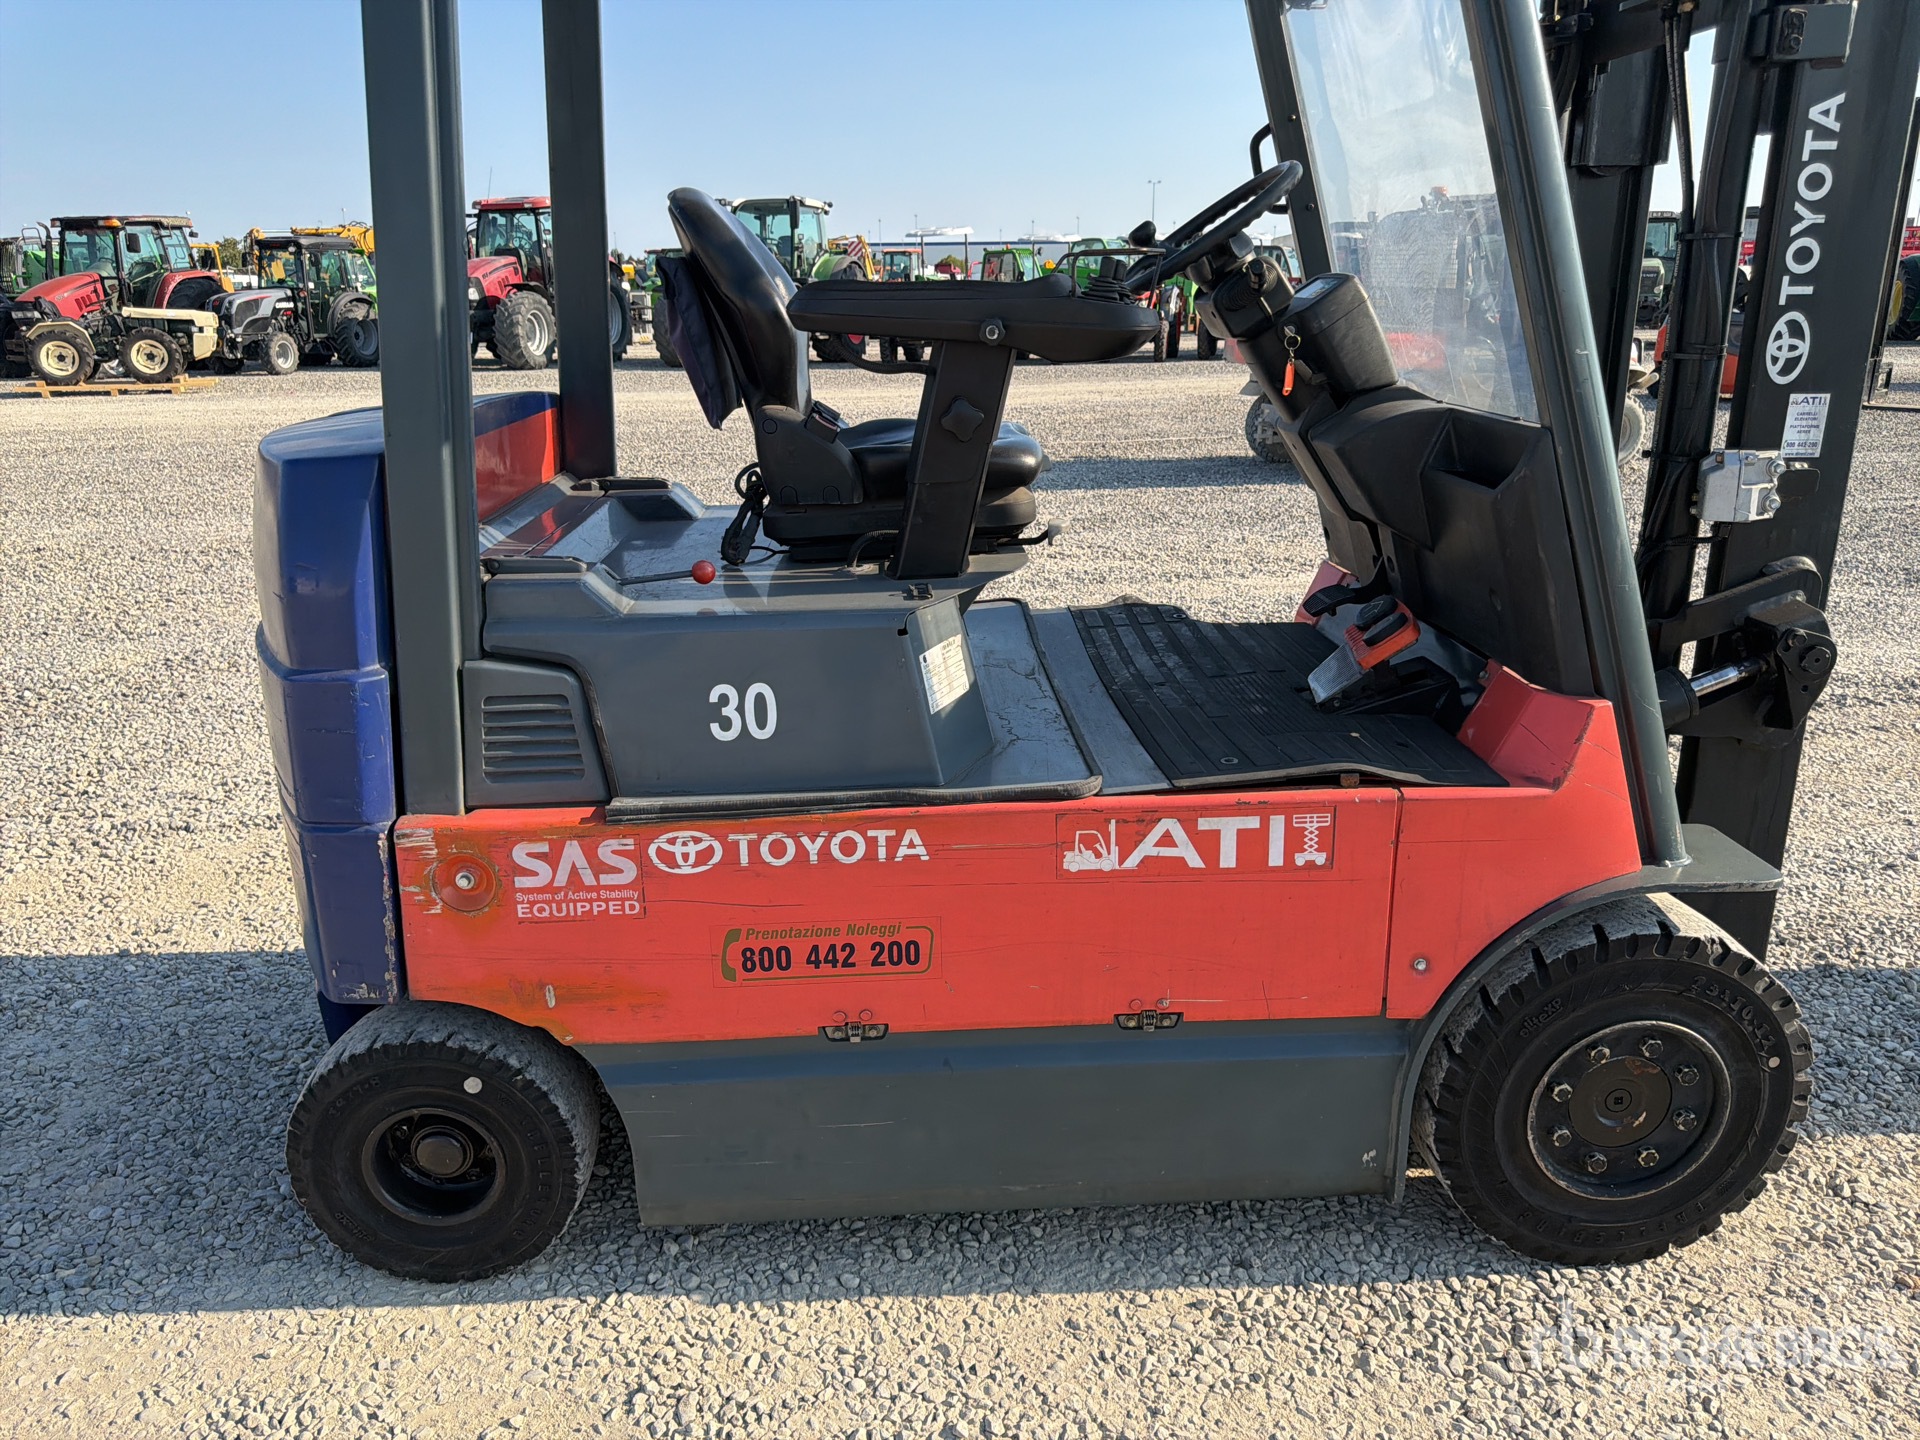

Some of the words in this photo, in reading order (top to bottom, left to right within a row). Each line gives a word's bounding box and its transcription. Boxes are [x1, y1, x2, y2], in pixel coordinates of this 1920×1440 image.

[1779, 92, 1846, 306] TOYOTA
[1799, 397, 1822, 405] ATI
[709, 683, 778, 741] 30
[727, 829, 930, 867] TOYOTA
[1120, 815, 1285, 869] ATI
[512, 838, 637, 888] SAS
[516, 892, 552, 903] System
[554, 891, 565, 900] of
[568, 890, 597, 900] Active
[600, 889, 639, 900] Stability
[517, 901, 640, 917] EQUIPPED
[745, 925, 841, 941] Prenotazione
[846, 922, 902, 938] Noleggi
[741, 945, 792, 973] 800
[806, 942, 856, 969] 442
[870, 940, 920, 967] 200
